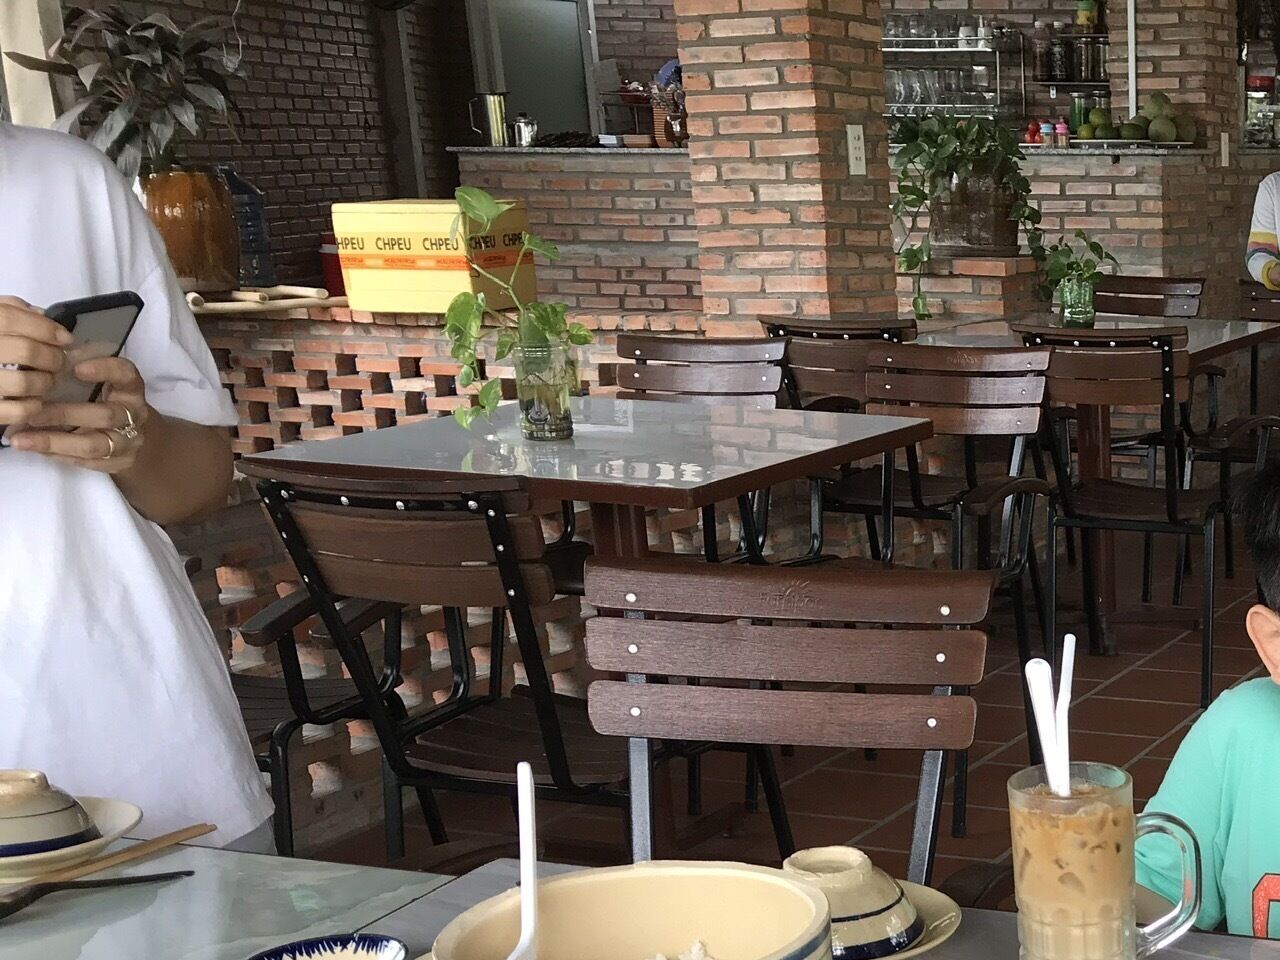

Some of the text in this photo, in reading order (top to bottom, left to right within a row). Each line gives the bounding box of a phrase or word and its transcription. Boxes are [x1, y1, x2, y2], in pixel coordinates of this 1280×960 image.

[336, 237, 459, 251] HPEU CHPEU CHPEU
[502, 232, 525, 247] CHPE
